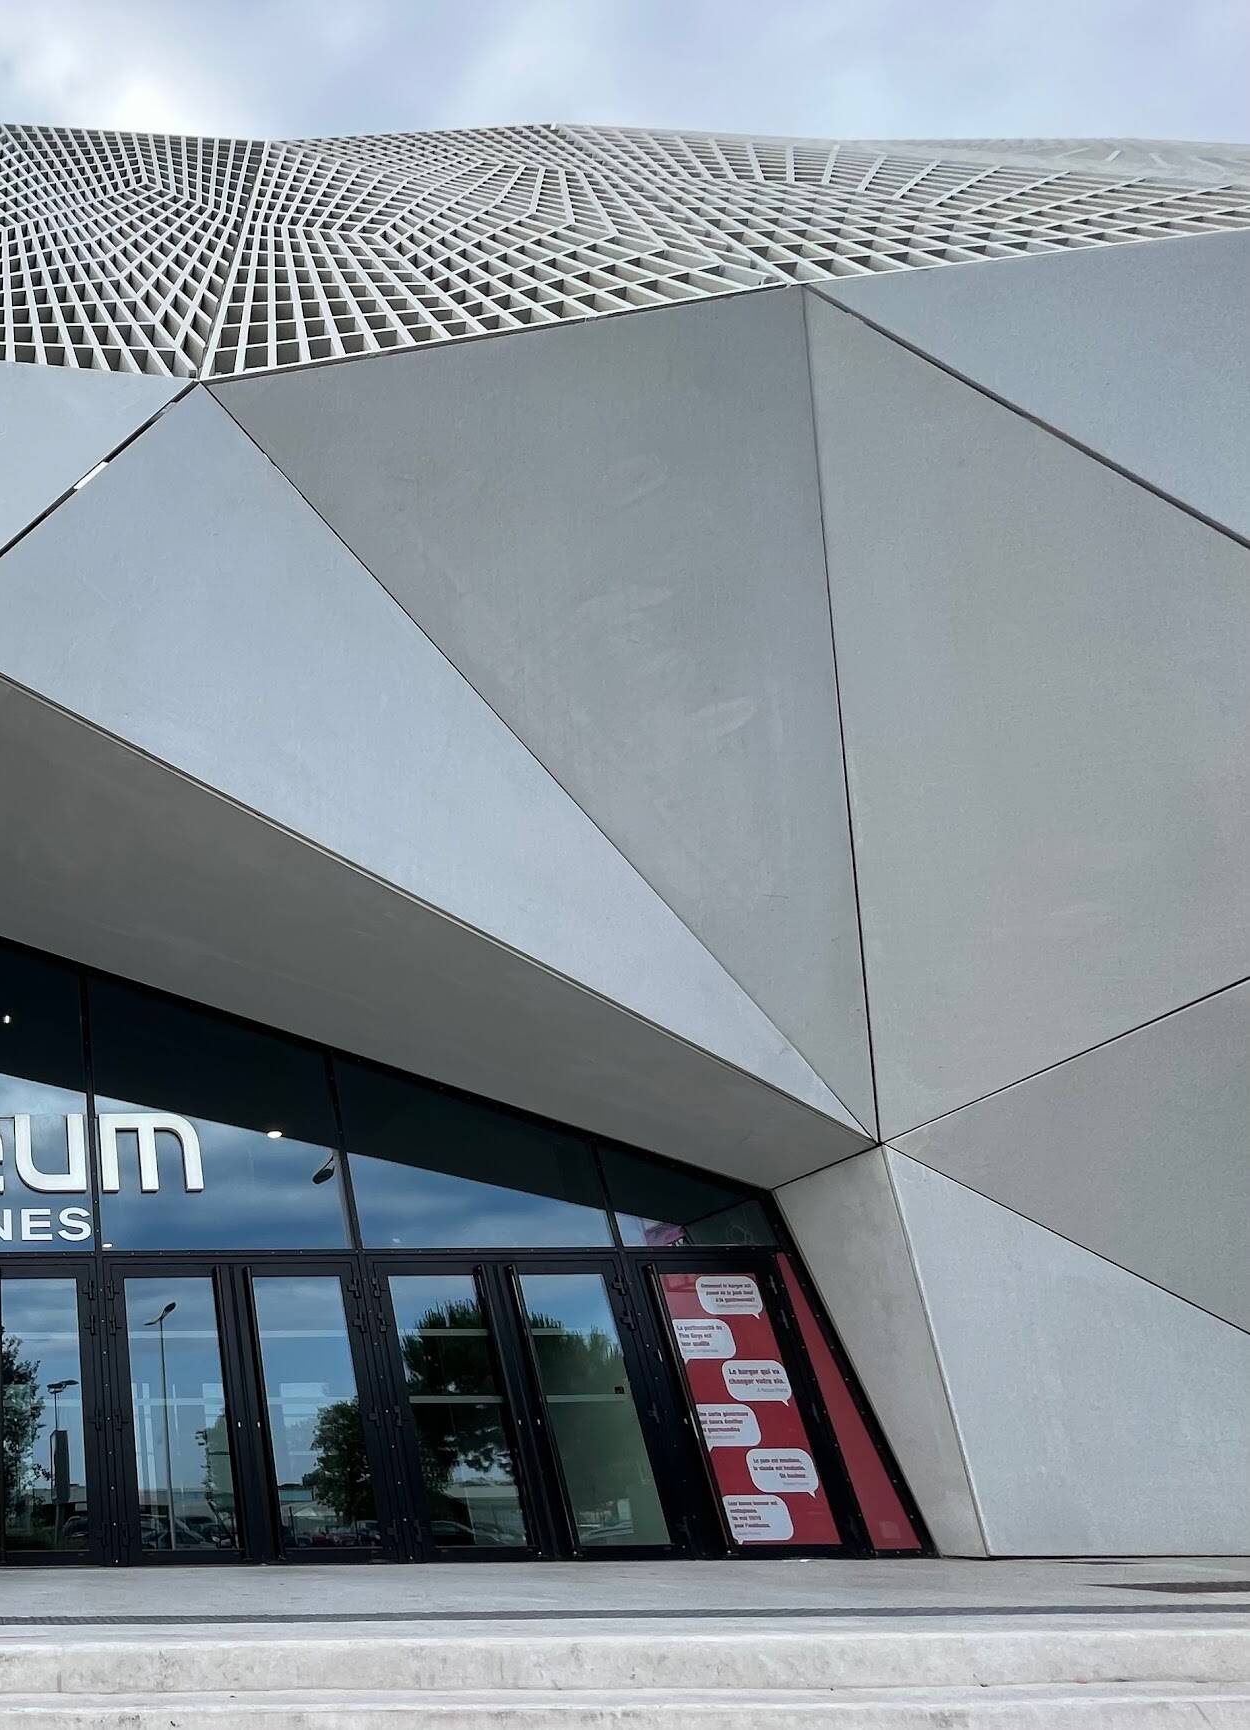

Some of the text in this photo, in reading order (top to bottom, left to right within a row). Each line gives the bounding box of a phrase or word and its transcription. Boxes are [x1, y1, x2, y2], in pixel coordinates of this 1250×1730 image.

[738, 1368, 758, 1376] burger
[760, 1368, 771, 1376] qui
[729, 1378, 754, 1386] changer
